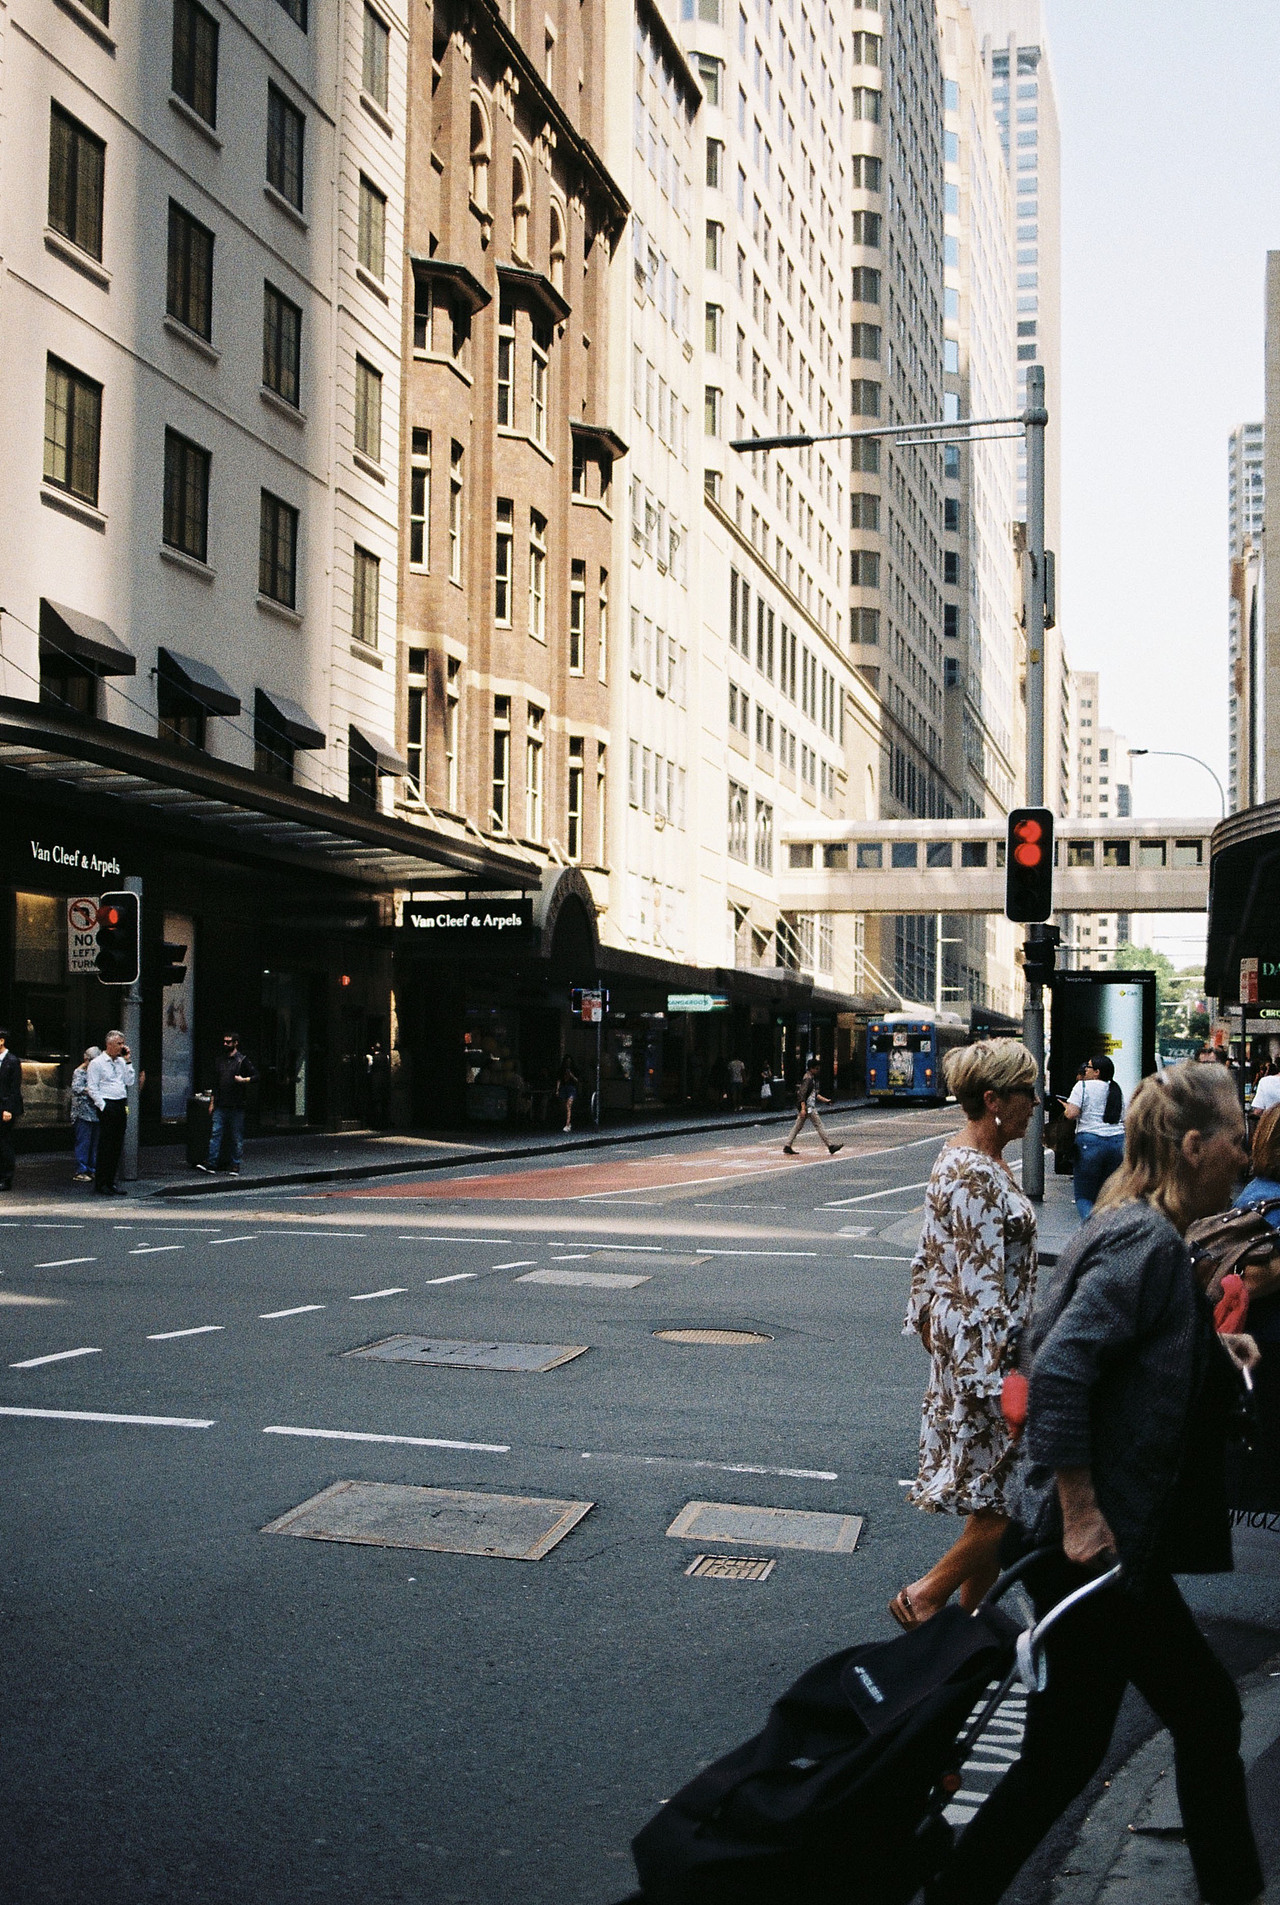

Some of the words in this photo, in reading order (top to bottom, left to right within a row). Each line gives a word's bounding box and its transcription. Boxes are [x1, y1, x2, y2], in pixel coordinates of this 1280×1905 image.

[31, 840, 50, 862] Van
[52, 845, 80, 867] Cleef
[81, 855, 88, 869] &
[90, 854, 120, 878] Arpels
[411, 914, 435, 928] Van
[436, 913, 470, 927] Cleef
[471, 916, 481, 927] &
[483, 913, 522, 930] Arpels
[74, 934, 93, 946] NO
[73, 948, 95, 958] LEFT
[72, 960, 96, 969] TURN
